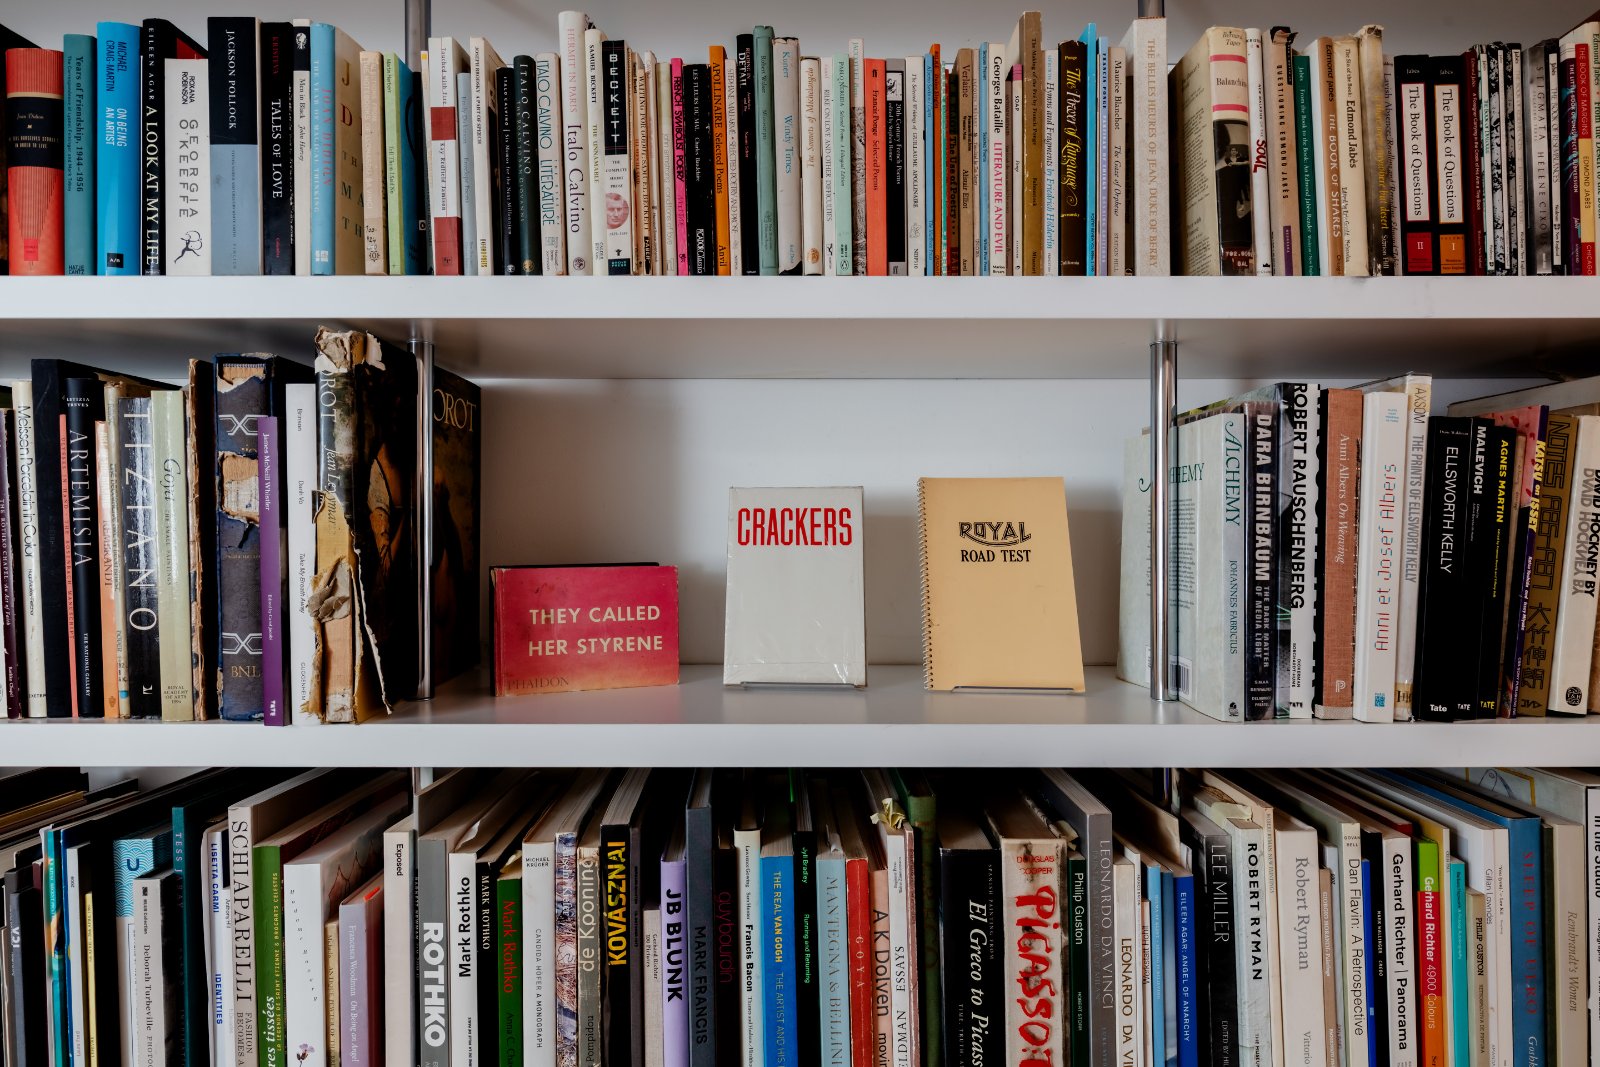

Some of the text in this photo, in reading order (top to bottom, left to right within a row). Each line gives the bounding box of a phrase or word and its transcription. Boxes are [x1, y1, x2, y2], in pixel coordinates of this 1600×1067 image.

[106, 40, 126, 92] MICHAEL CRAIG-MARTIN
[226, 30, 236, 129] JACKSON POLLOCK
[1148, 39, 1156, 59] THE
[1148, 62, 1156, 96] BELLES
[106, 107, 114, 145] AN ARTIST
[117, 108, 127, 146] ON BEING
[146, 106, 157, 116] A
[609, 54, 620, 143] BECKETT
[712, 62, 724, 194] APOLLINAIRE Selected Poems
[1148, 100, 1157, 138] HEURES
[146, 122, 158, 167] LOOK
[271, 99, 282, 198] TALES OF LOVE
[536, 60, 554, 226] ITALO CALVINO LITERATURE
[992, 56, 1003, 254] Georges Bataille LITERATURE AND EVIL
[1149, 142, 1157, 155] OF
[1254, 139, 1267, 173] SOUL
[1346, 100, 1359, 168] Edmond Jabès
[1409, 87, 1423, 216] The Book of Questions
[1442, 89, 1456, 218] The Book of Questions
[147, 173, 158, 192] AT
[190, 120, 198, 217] GEORGIA
[568, 124, 584, 234] Italo Calvino
[1148, 188, 1158, 215] DUKE
[147, 198, 158, 224] MY
[1149, 219, 1158, 233] OF
[147, 229, 159, 265] LIFE
[719, 245, 727, 267] Anvil
[1149, 235, 1158, 267] BERRY
[1414, 387, 1427, 424] AXSOM
[262, 434, 271, 453] James
[1225, 421, 1243, 526] ALCHEMY
[1473, 426, 1486, 494] MALEVICH
[69, 430, 92, 566] ARTEMISIA
[162, 459, 181, 502] Goya
[1255, 414, 1272, 581] DARA BIRNBAUM
[1290, 383, 1308, 609] ROBERT RAUSCHENBERG
[1336, 434, 1349, 564] Anni Albers On Weaving
[1440, 446, 1458, 573] ELLSWORTH KELLY
[1496, 440, 1508, 522] AGNES MARTIN
[1528, 440, 1546, 532] KATSU on ISSEY
[124, 410, 156, 630] TIZIANO
[737, 507, 853, 547] CRACKERS
[959, 521, 1032, 548] ROYAL
[960, 549, 1031, 563] ROAD TEST
[1375, 464, 1397, 651] Anni et Josef Albers
[529, 605, 660, 625] THEY CALLED
[1229, 560, 1239, 654] JOHANNES FABRICIUS
[1256, 586, 1262, 597] OF
[529, 635, 664, 657] HER STYRENE
[507, 676, 569, 689] PHAIDON
[1430, 704, 1448, 712] Tate
[395, 844, 403, 876] Exposed
[1212, 845, 1229, 942] LEE MILLER
[1393, 853, 1404, 911] Gerhard
[231, 821, 252, 1001] SCHIAPARELLI
[458, 877, 471, 978] Mark Rothko
[482, 909, 490, 949] ROTHKO
[1072, 873, 1084, 944] Philip Guston
[1100, 840, 1113, 1009] LEONARDO DA VINCI
[1180, 892, 1188, 923] EILEEN
[1248, 843, 1262, 980] ROBERT RYMAN
[1294, 857, 1310, 969] Robert Ryman
[1395, 916, 1406, 965] Richter
[503, 901, 518, 993] Mark Rothko
[666, 888, 683, 1002] JB BLUNK
[745, 925, 754, 959] Francis
[873, 909, 891, 1017] A K Dolven
[969, 900, 988, 1005] El Greco to
[1348, 859, 1364, 1035] Dan Flavin: A Retrospective
[1424, 877, 1437, 1028] Gerhard Richter 4900 Colours
[215, 973, 223, 1024] IDENTITIES
[423, 922, 446, 1047] ROTHKO
[746, 962, 754, 991] Bacon
[1182, 987, 1189, 997] OF
[1396, 978, 1408, 1050] Panorama
